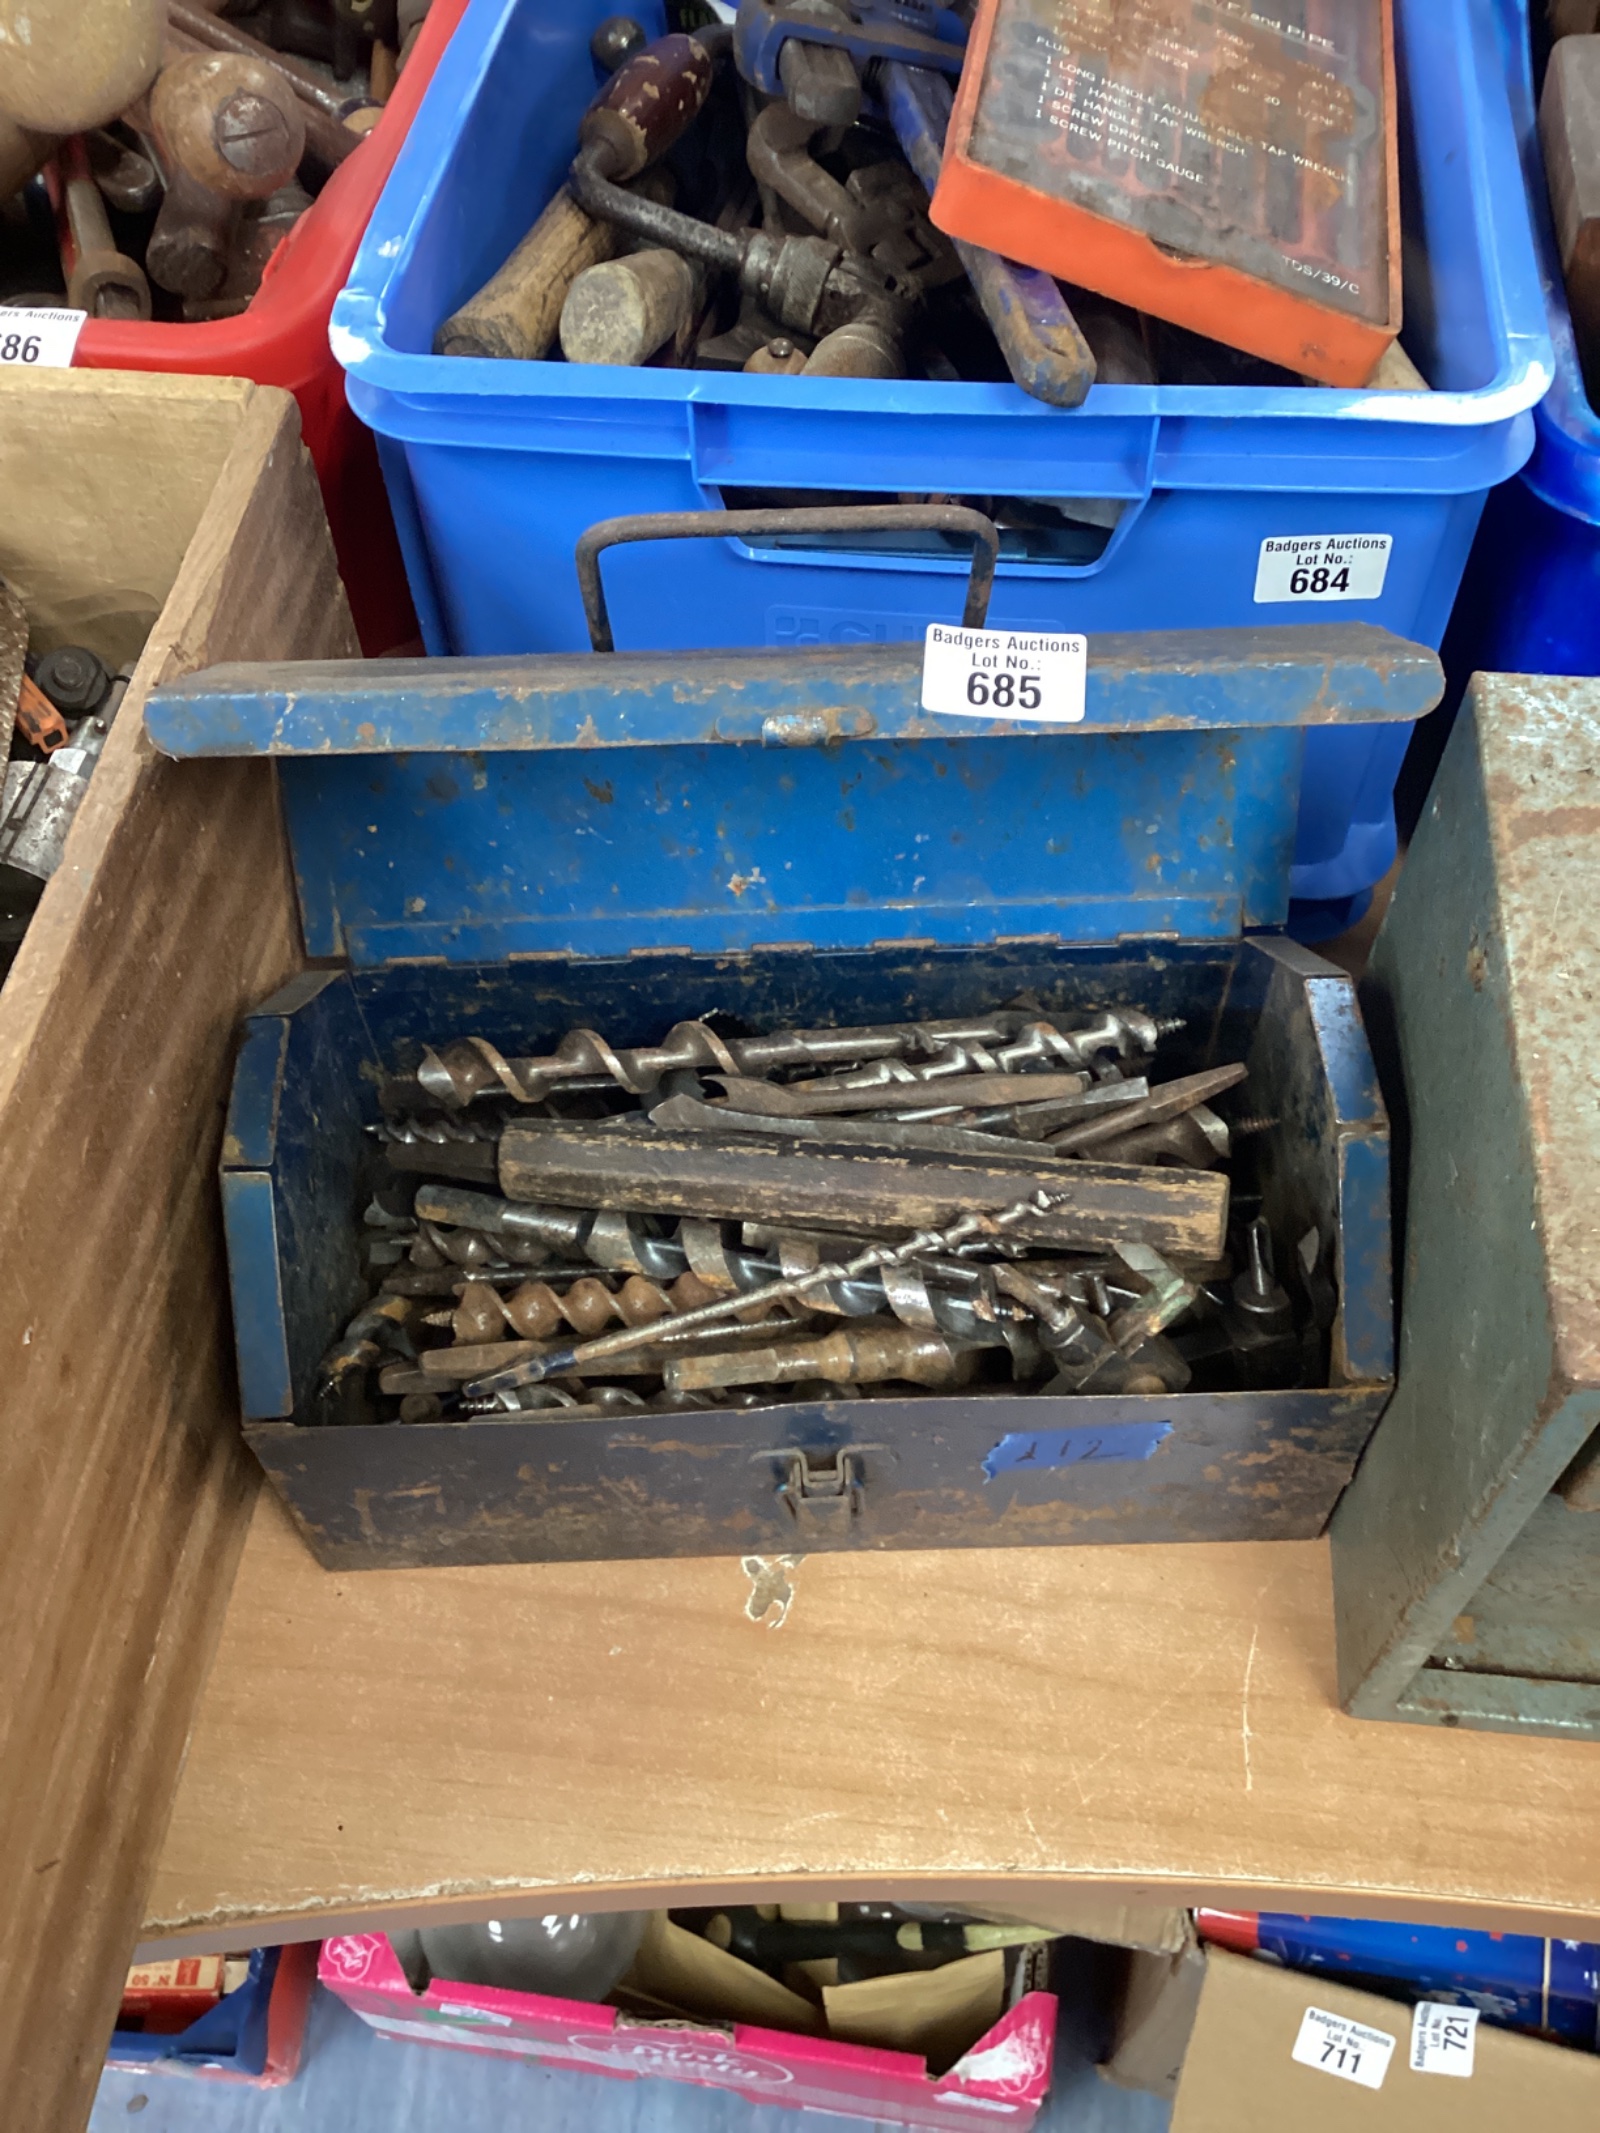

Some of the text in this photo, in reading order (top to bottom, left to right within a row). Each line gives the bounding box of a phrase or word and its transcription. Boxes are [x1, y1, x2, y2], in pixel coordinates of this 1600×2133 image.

[1036, 35, 1070, 55] PLUS
[1054, 86, 1077, 103] DIE
[1088, 86, 1144, 115] HANDLE
[1153, 111, 1179, 128] TAP
[1051, 100, 1105, 127] SCREW
[1059, 60, 1096, 82] LONG
[1101, 77, 1155, 106] HANDLE
[1260, 140, 1287, 157] TAP
[1049, 114, 1102, 142] SCREW
[1107, 138, 1151, 162] PITCH
[1281, 254, 1360, 294] TDS/39/C
[25, 310, 81, 322] Auctions
[0, 333, 42, 363] 86
[1265, 537, 1387, 553] Badgers Auctions
[1296, 554, 1318, 566] Lot
[1289, 567, 1350, 594] 684
[932, 628, 1000, 649] Badgers
[1007, 636, 1080, 653] Auctions
[971, 653, 998, 668] Lot
[966, 671, 1042, 709] 685
[1308, 2009, 1391, 2048] Badgers Auctions
[1326, 2030, 1343, 2043] Lot
[1430, 2030, 1440, 2047] Lot
[1443, 2016, 1470, 2051] 721
[1320, 2041, 1361, 2074] 711
[1414, 2031, 1428, 2067] Badgers
